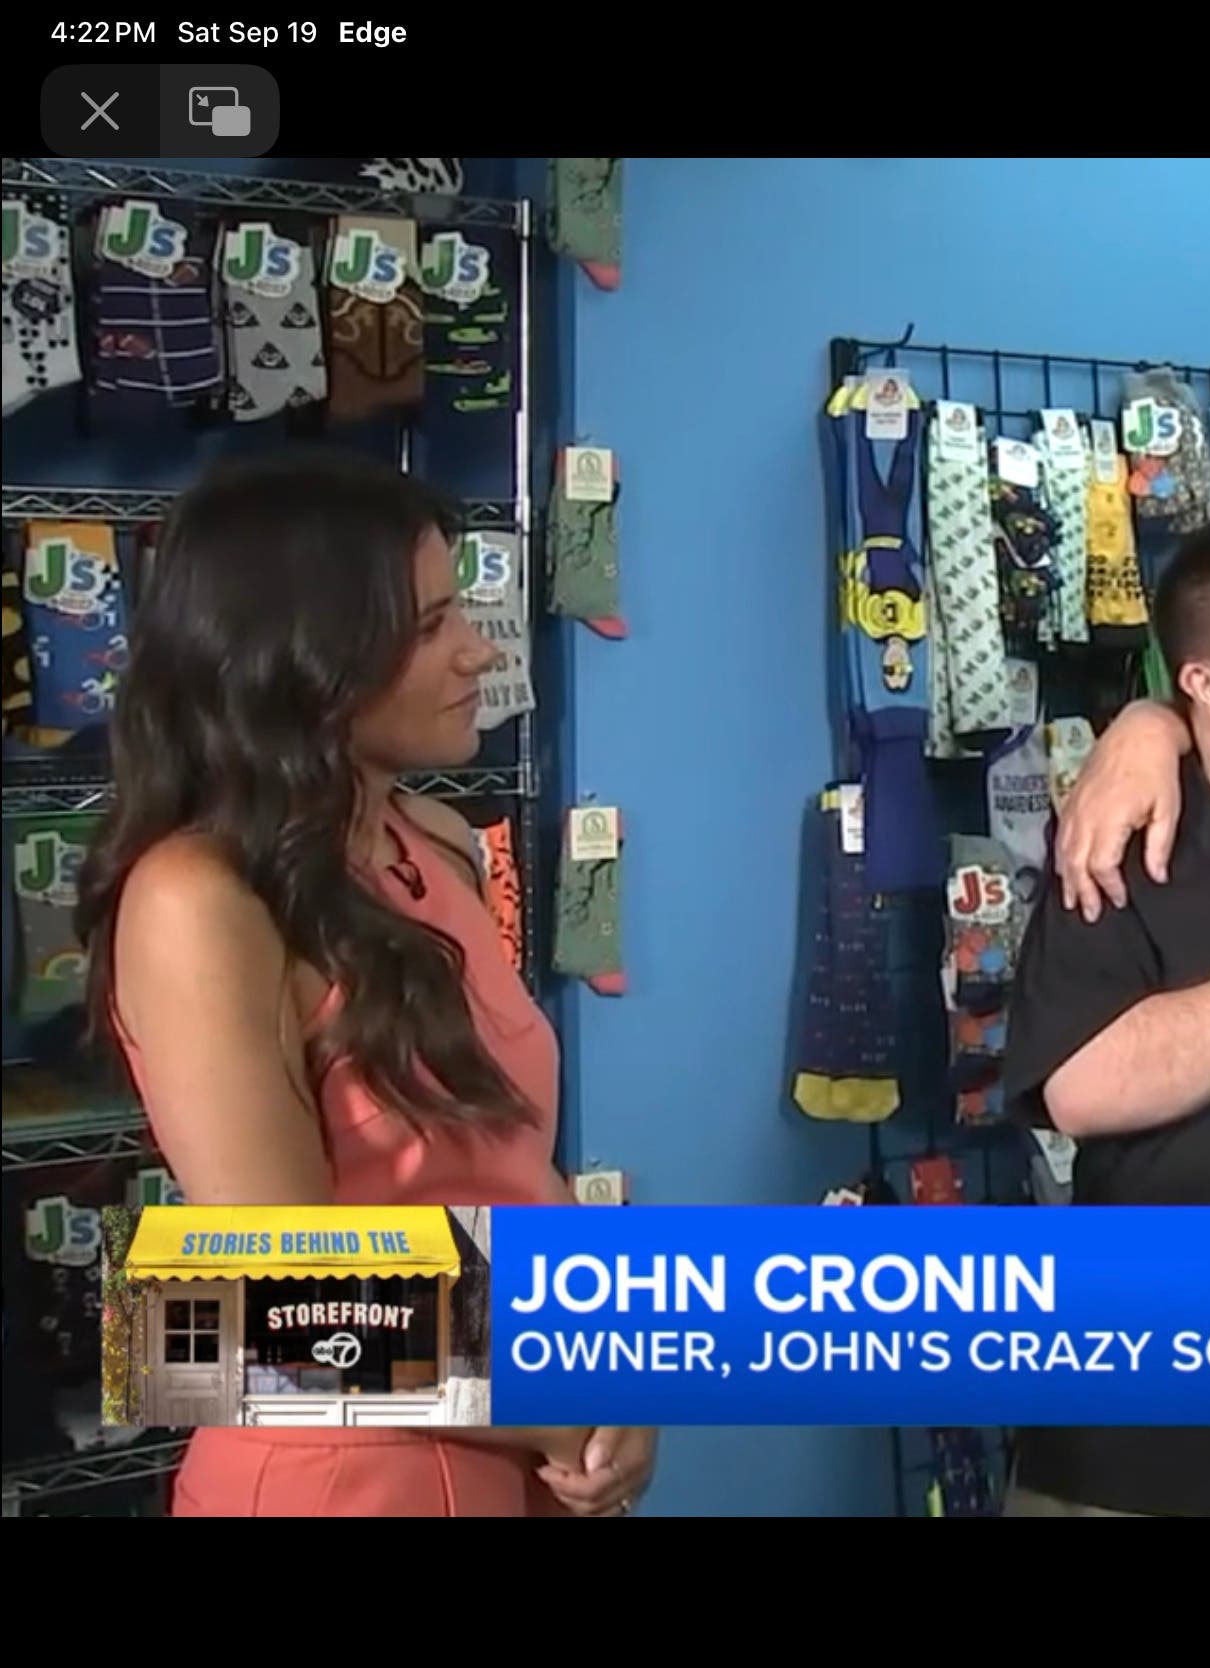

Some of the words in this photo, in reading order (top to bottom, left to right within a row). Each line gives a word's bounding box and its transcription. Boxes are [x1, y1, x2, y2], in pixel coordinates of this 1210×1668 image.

[50, 21, 110, 43] 4:22
[115, 21, 155, 43] PM
[178, 21, 220, 43] Sat
[229, 21, 279, 48] Sep
[287, 21, 317, 43] 19
[339, 20, 407, 48] Edge
